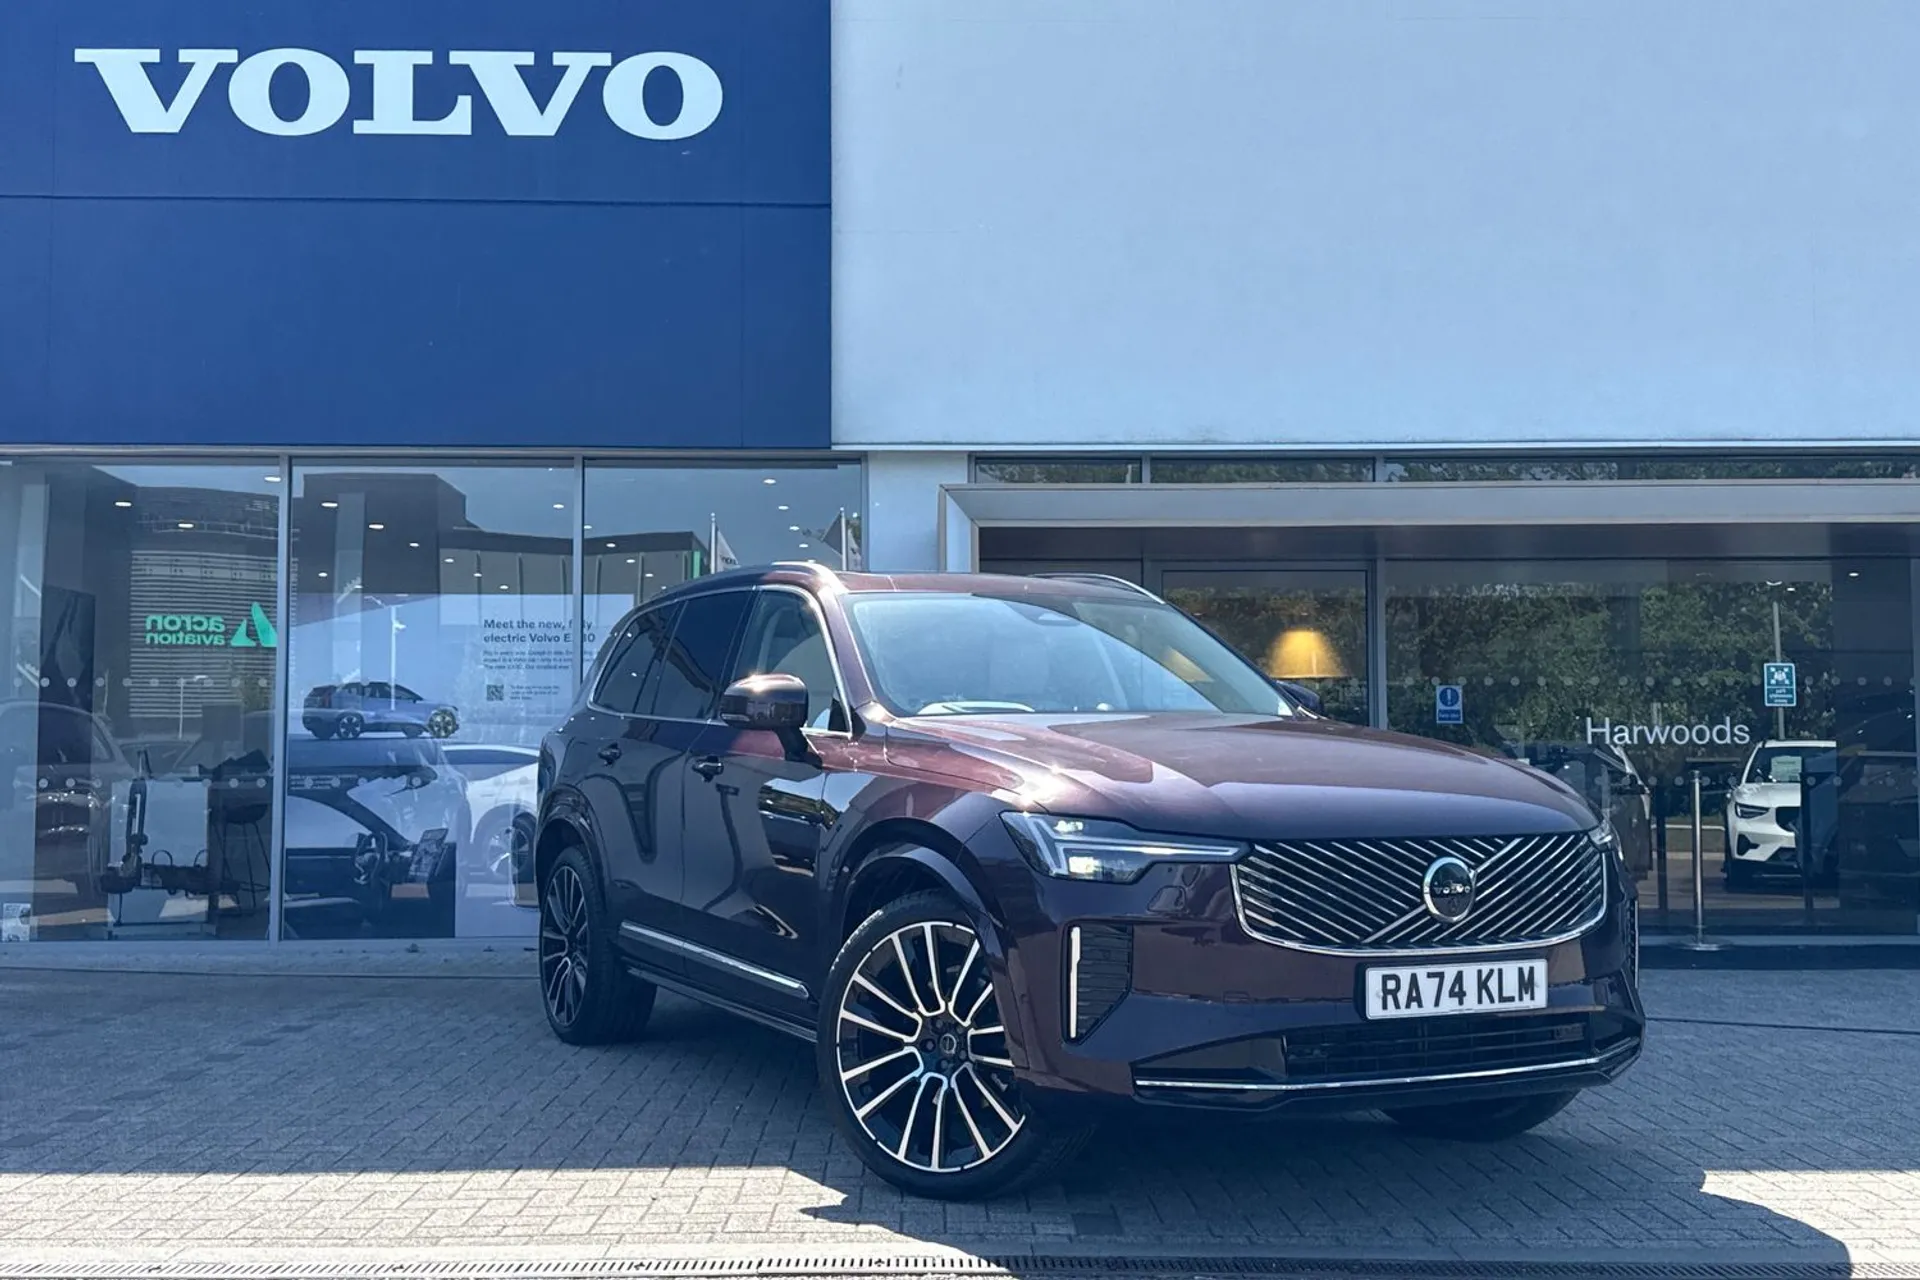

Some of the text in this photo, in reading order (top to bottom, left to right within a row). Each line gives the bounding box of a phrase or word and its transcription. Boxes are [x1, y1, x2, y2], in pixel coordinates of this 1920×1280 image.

[75, 48, 723, 140] VOLVO
[483, 619, 514, 629] Meet
[517, 619, 536, 629] the
[538, 621, 566, 630] new,
[483, 633, 596, 643] electric Volvo E0
[1586, 716, 1751, 745] Harwoods
[1381, 966, 1535, 1010] RA74 KLM
